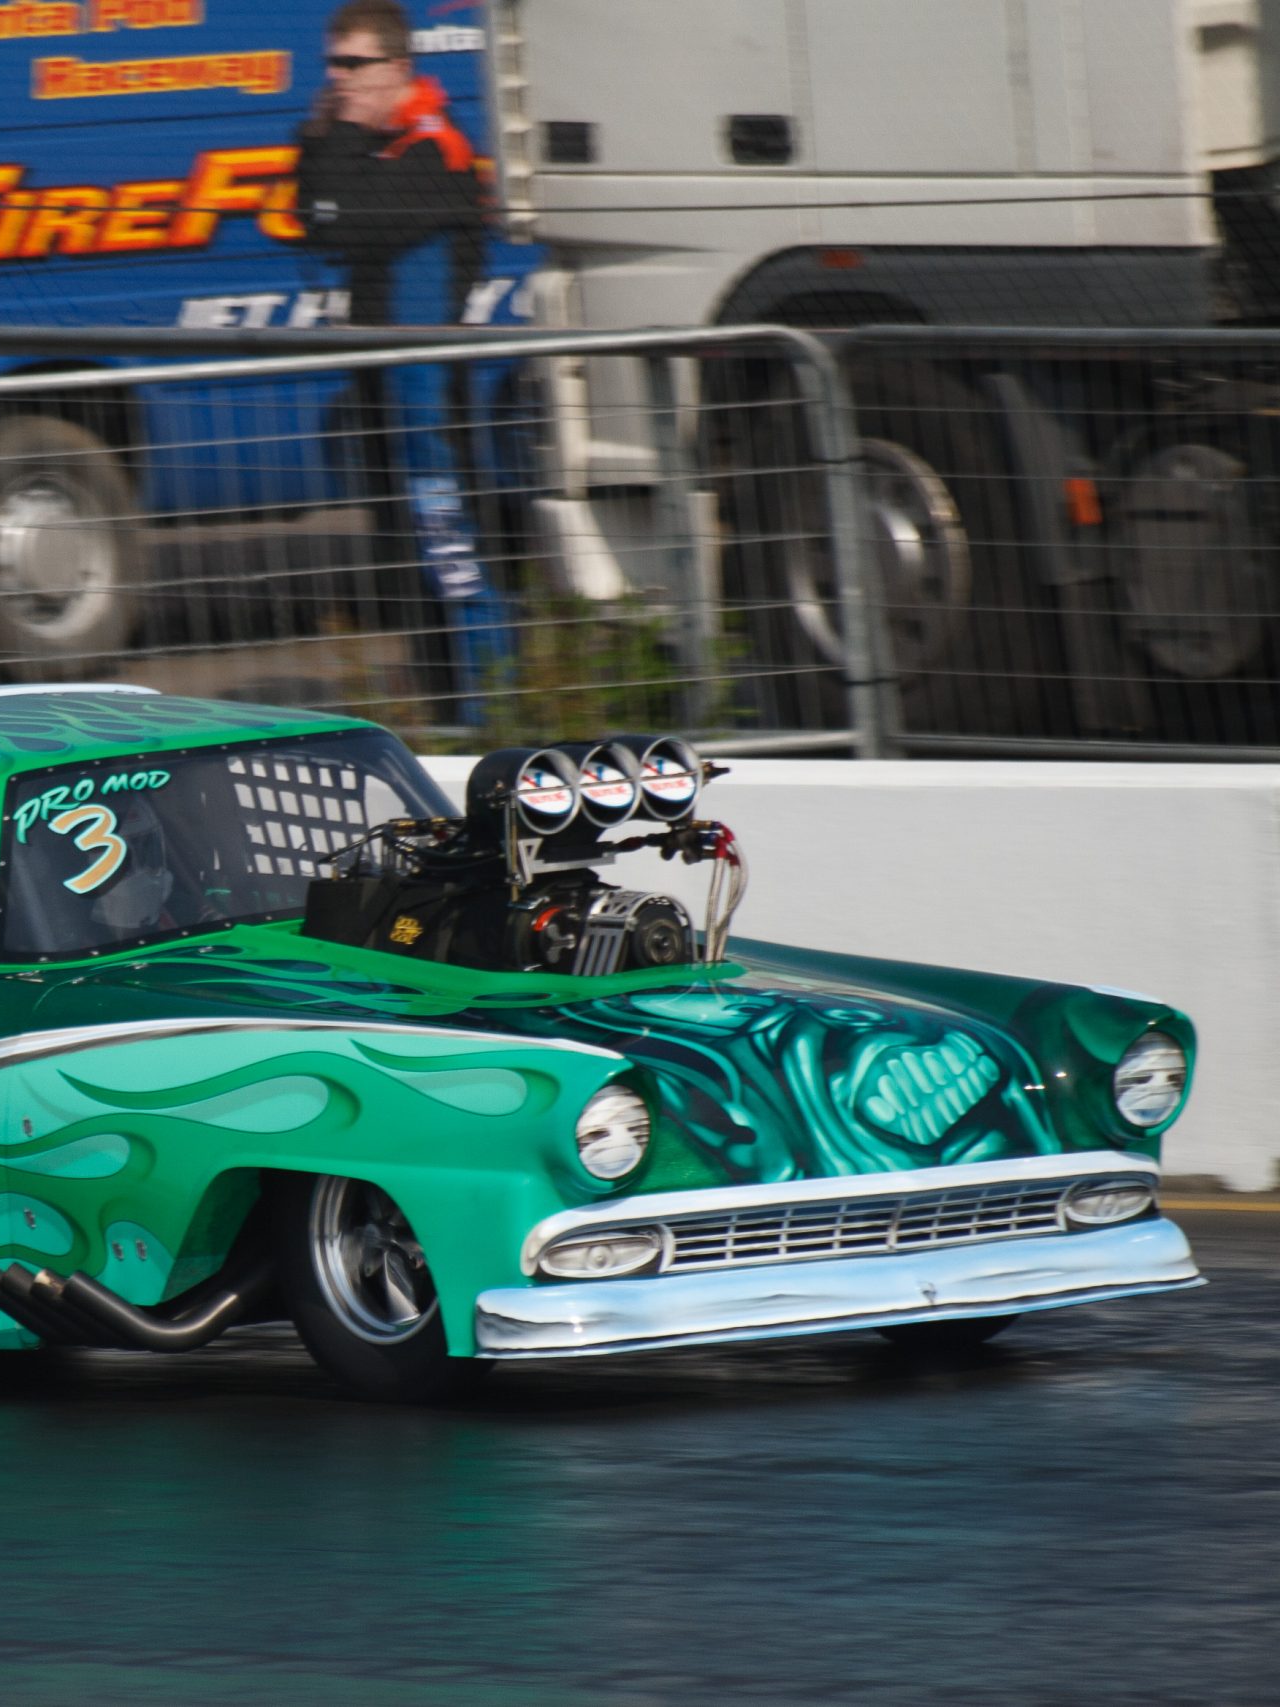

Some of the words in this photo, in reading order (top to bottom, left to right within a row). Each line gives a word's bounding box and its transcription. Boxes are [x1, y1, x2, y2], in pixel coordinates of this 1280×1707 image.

[12, 778, 95, 844] PRO
[100, 770, 171, 795] MOD
[47, 803, 127, 894] 3
